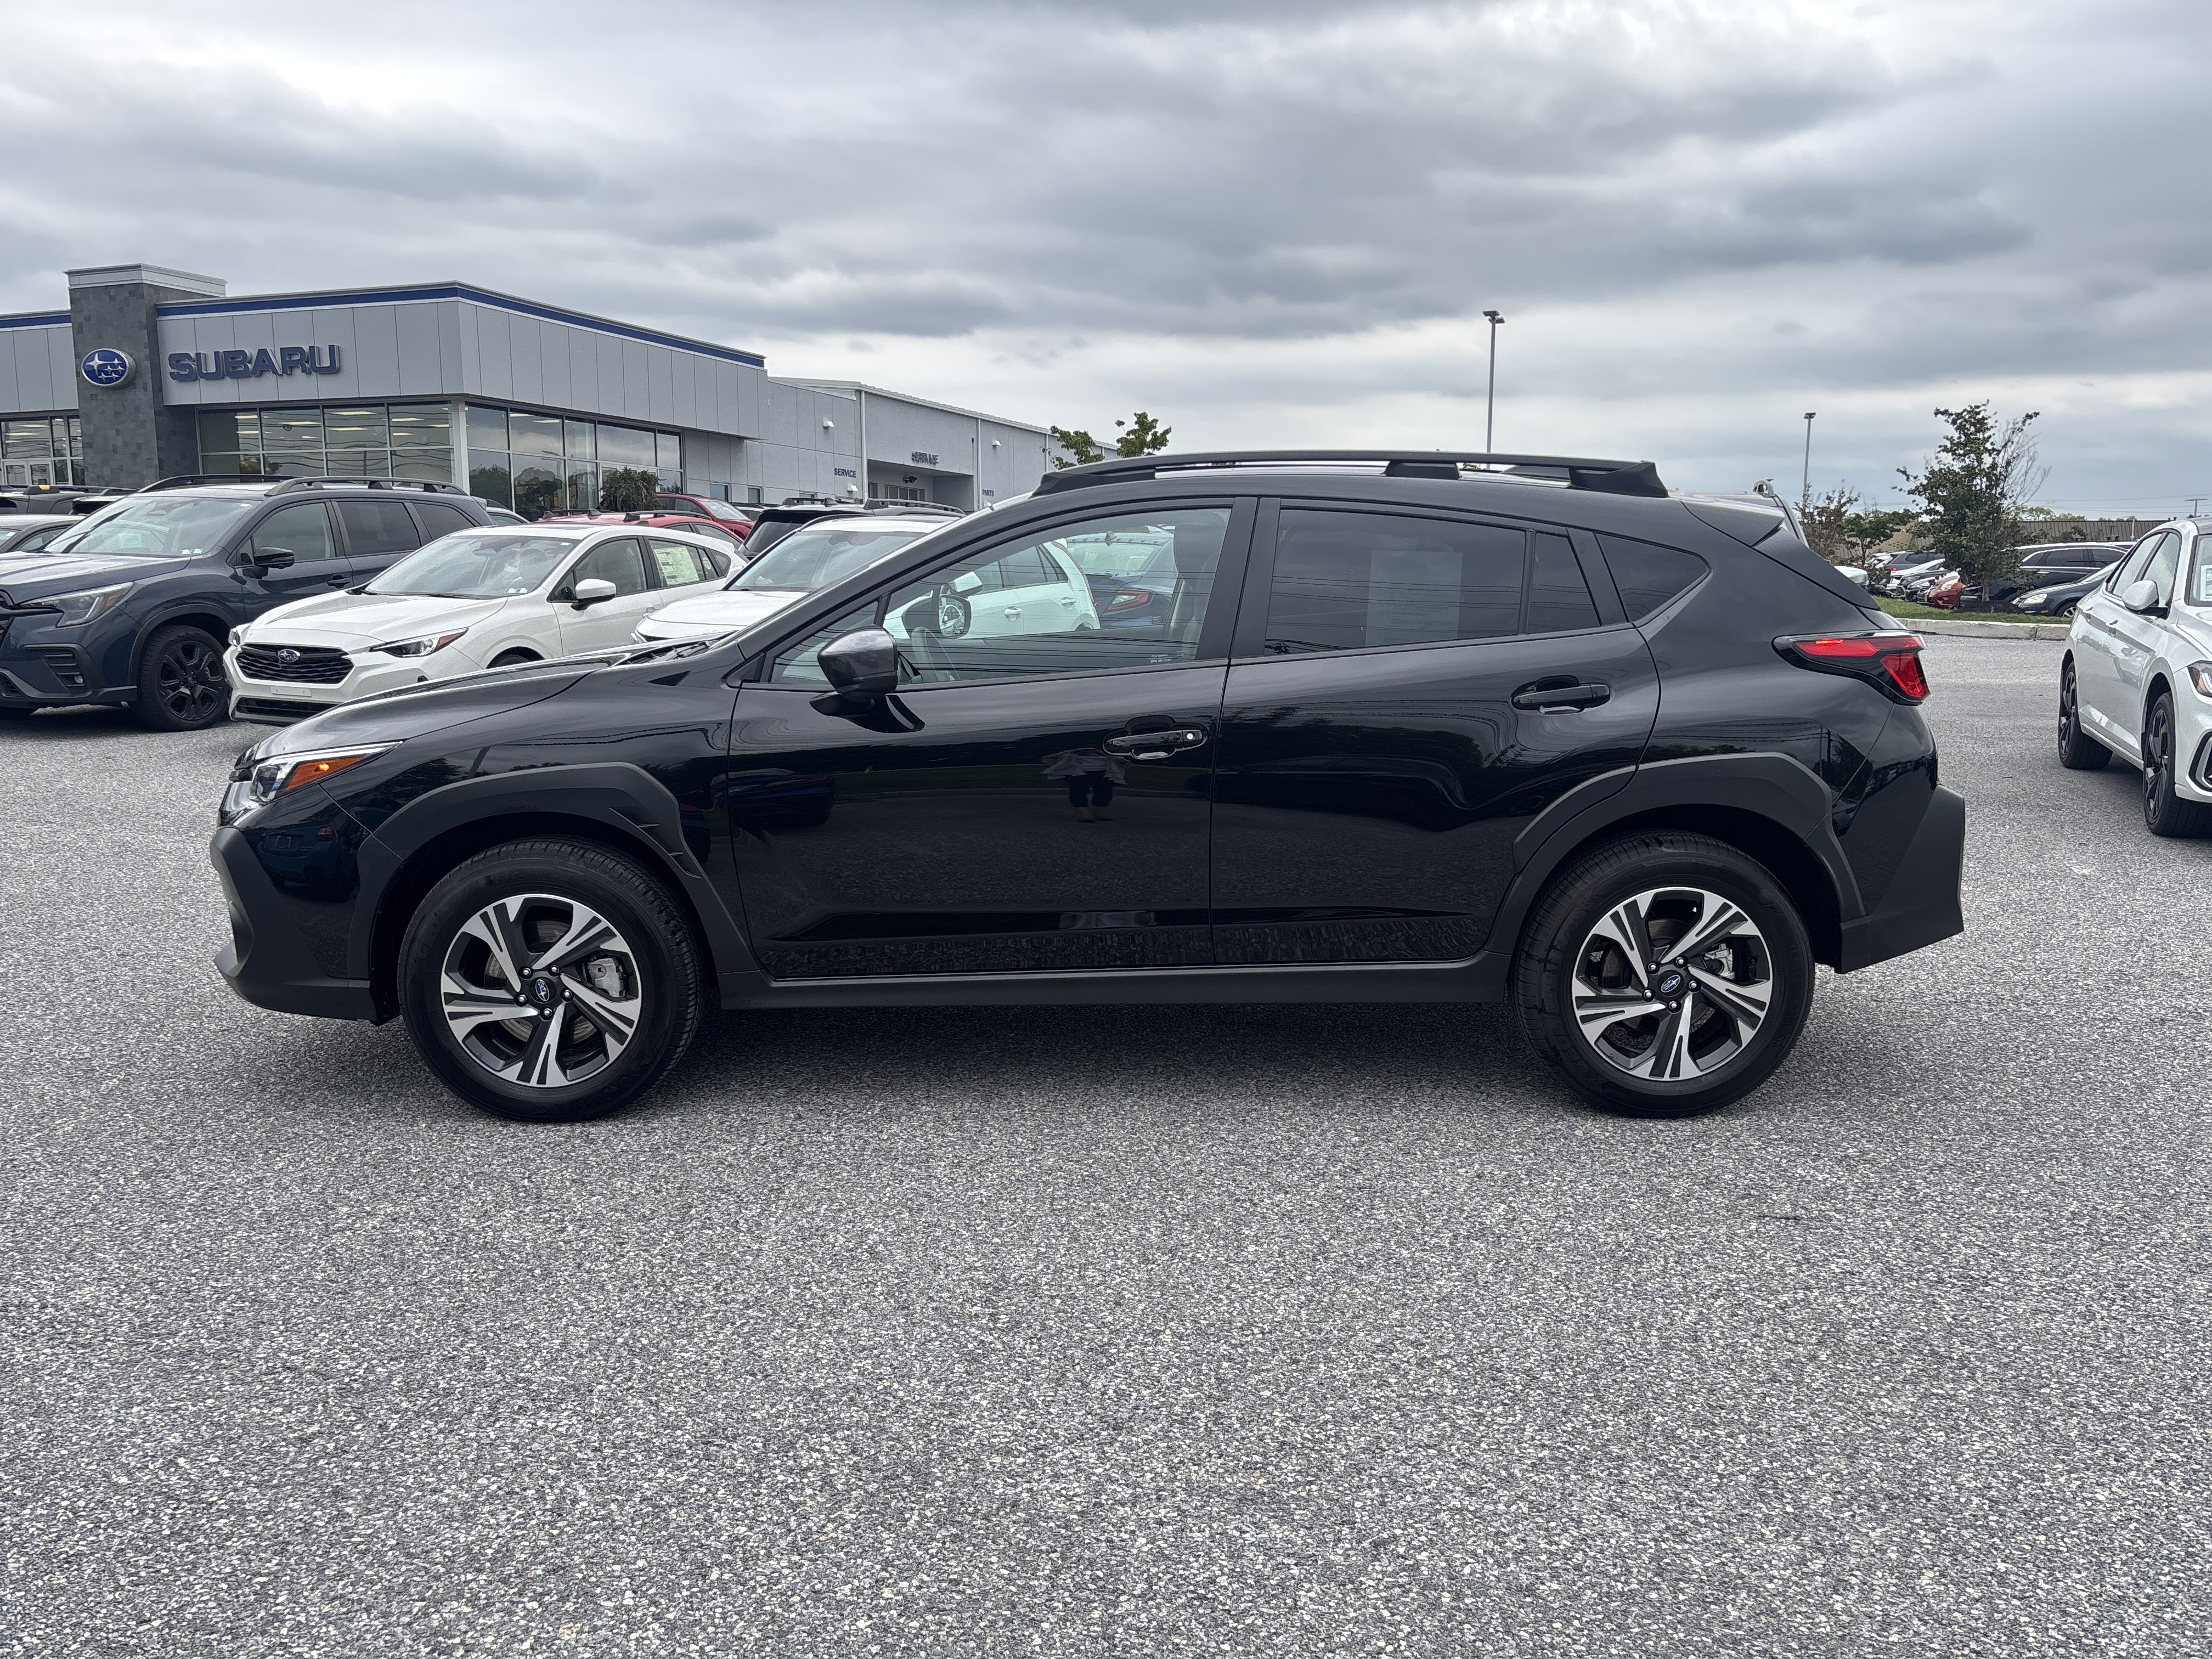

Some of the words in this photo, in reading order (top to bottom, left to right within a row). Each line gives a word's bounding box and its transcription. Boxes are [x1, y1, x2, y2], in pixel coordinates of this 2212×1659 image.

[168, 345, 338, 381] SUBARU
[834, 467, 856, 478] SERVICE
[982, 489, 994, 497] PARTS
